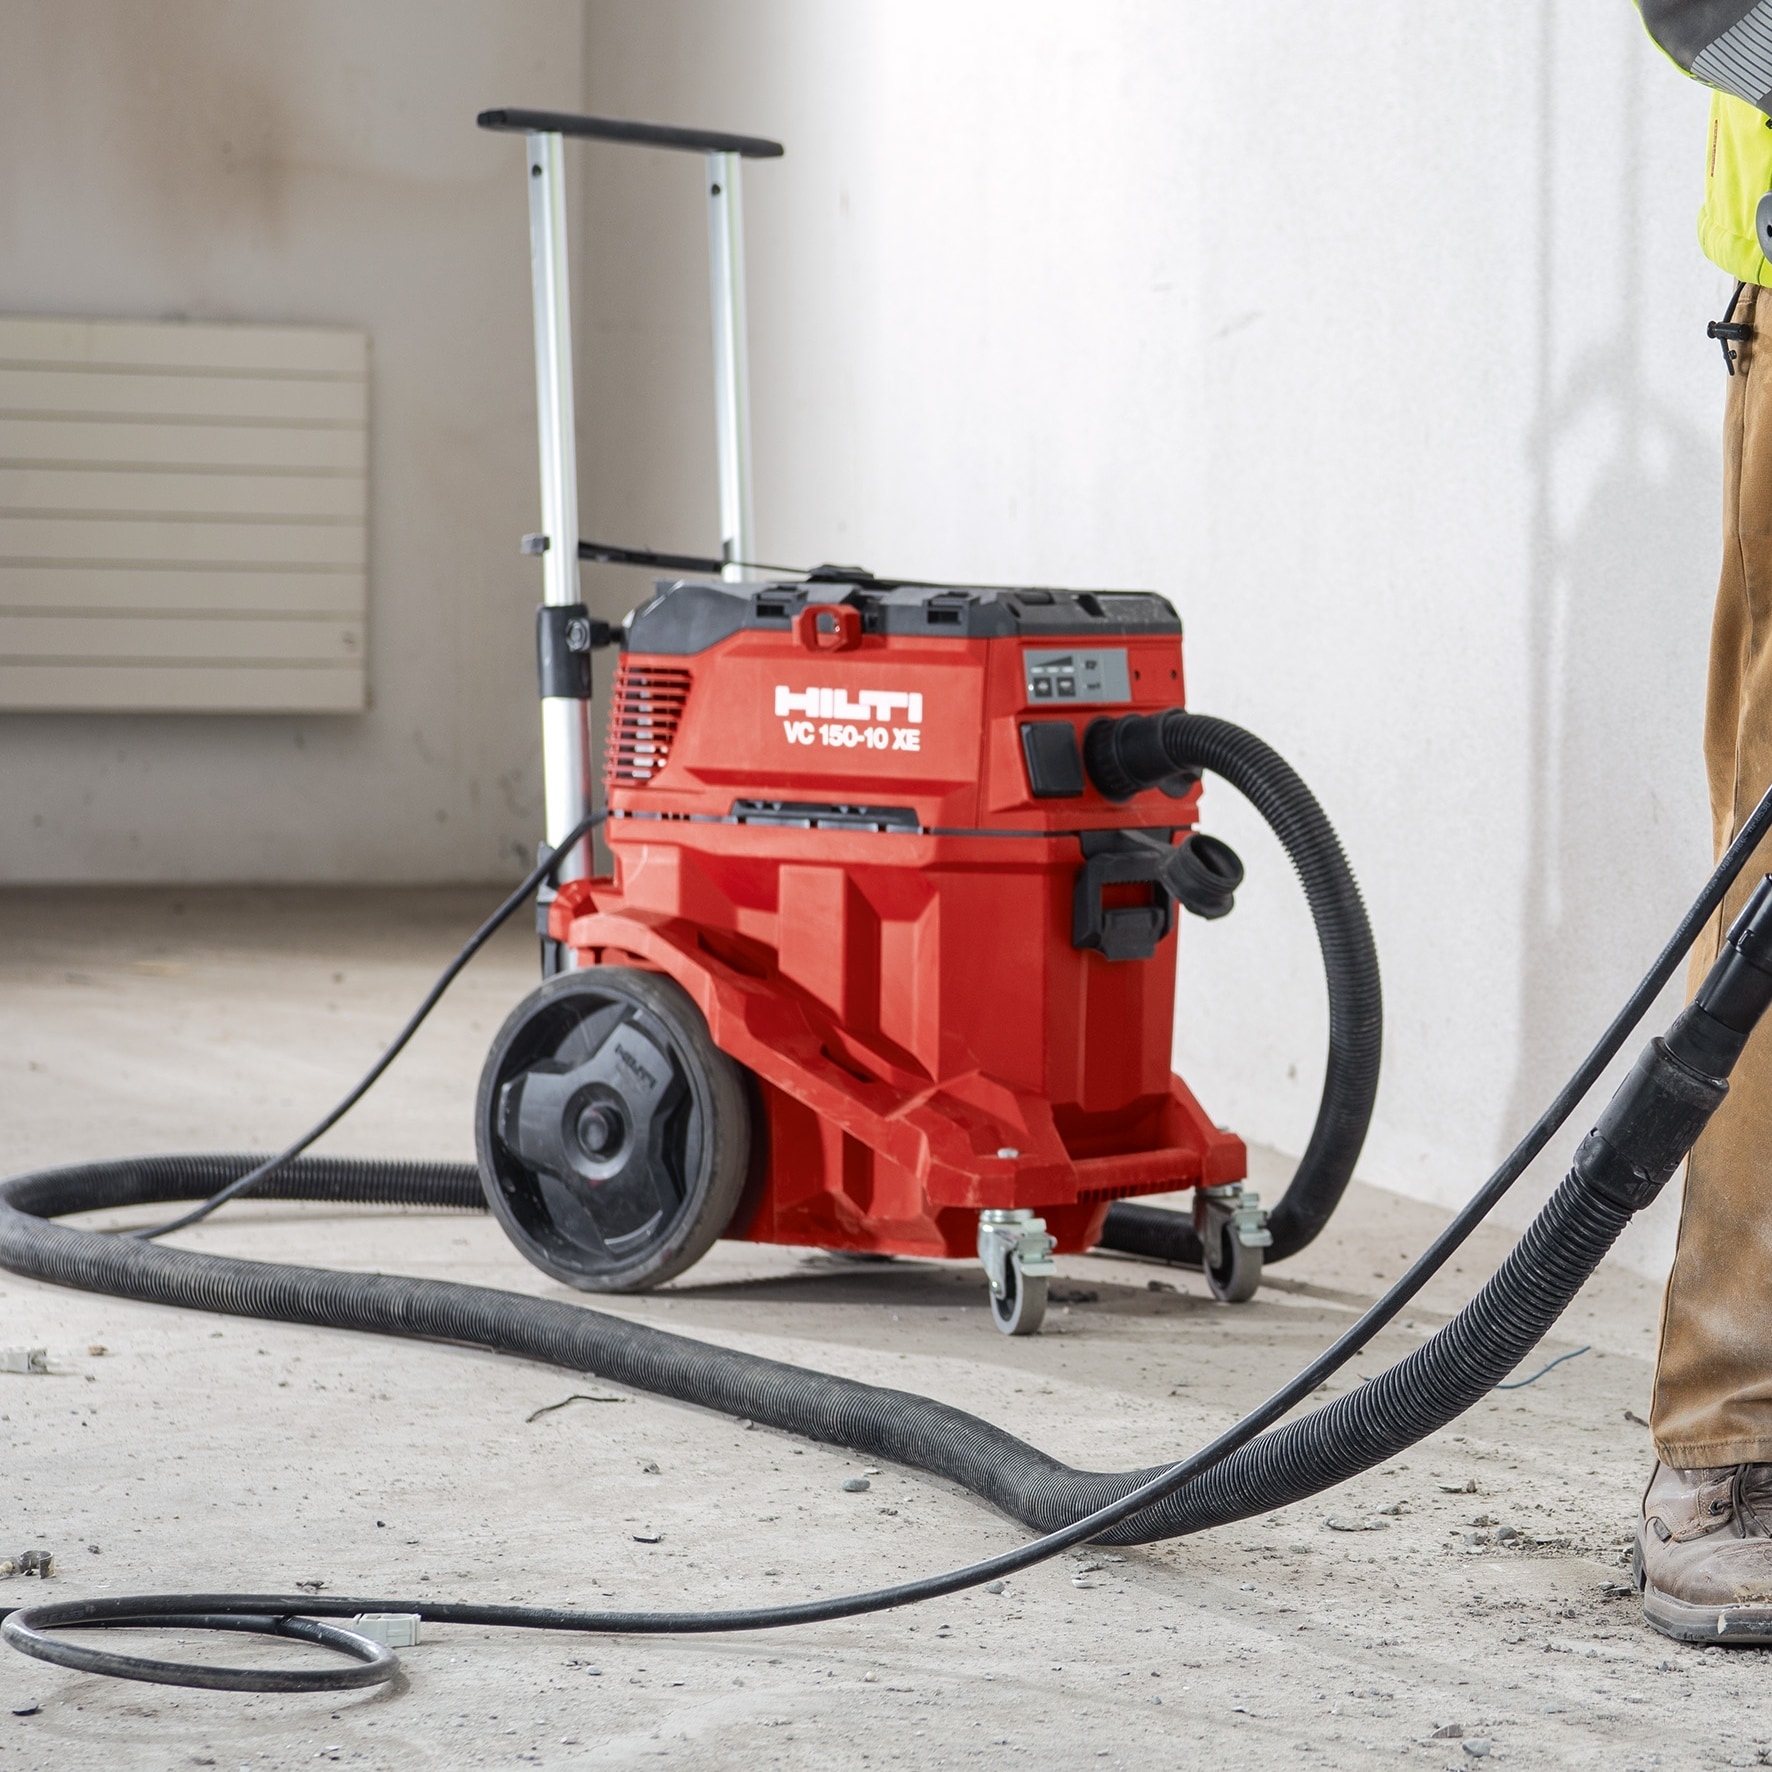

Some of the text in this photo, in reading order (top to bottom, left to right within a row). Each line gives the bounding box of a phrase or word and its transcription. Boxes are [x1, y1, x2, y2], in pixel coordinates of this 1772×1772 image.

[775, 685, 923, 724] HILTI
[783, 720, 921, 752] VC 150-10 XE
